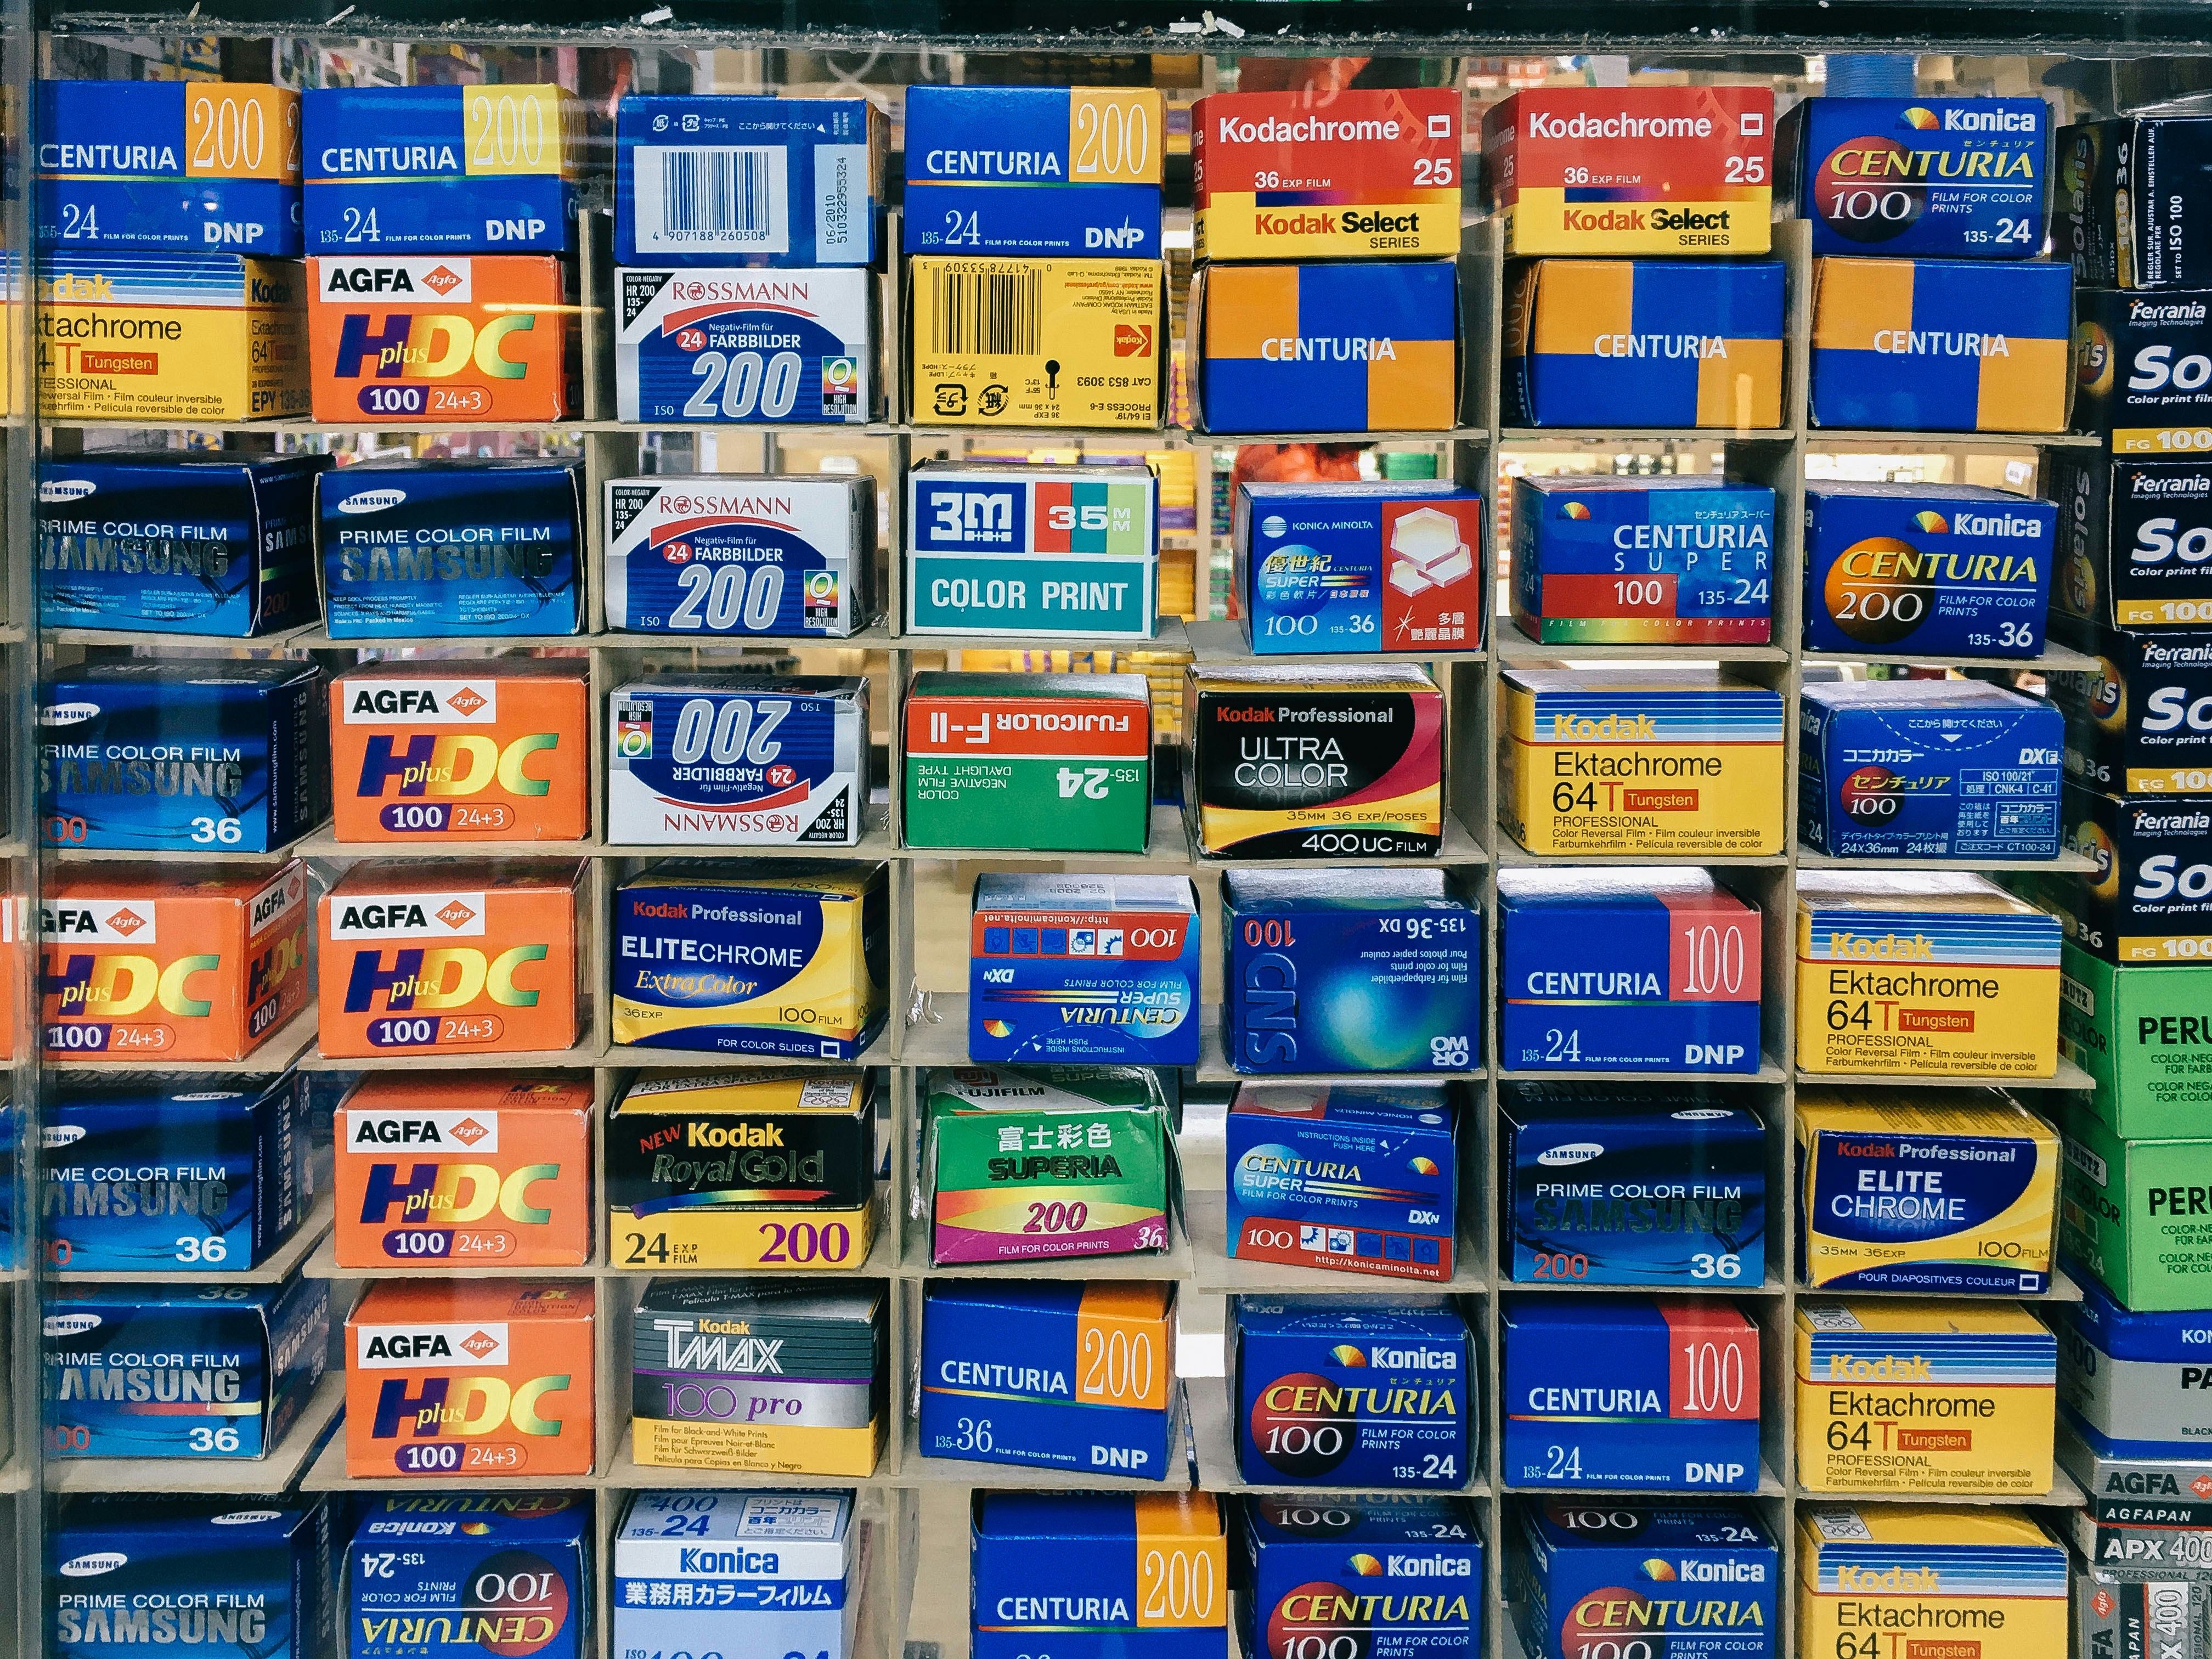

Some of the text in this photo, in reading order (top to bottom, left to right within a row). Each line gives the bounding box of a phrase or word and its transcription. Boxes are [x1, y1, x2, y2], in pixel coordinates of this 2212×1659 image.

[472, 95, 543, 166] 200
[1220, 116, 1400, 143] Kodachrome
[1530, 112, 1712, 139] Kodachrome
[1945, 108, 2035, 132] Konica
[322, 146, 457, 172] CENTURIA
[927, 151, 1061, 176] CENTURIA
[1255, 171, 1331, 188] 36 EXP FILM
[1413, 159, 1452, 185] 25
[1828, 191, 1912, 220] 100
[1932, 193, 2033, 203] FILM FOR COLOR
[1932, 204, 1973, 214] PRINTS
[2170, 196, 2182, 220] 100
[487, 219, 545, 240] DNP
[826, 194, 836, 244] 06/2010
[1255, 211, 1419, 235] Kodak Select
[204, 223, 263, 244] DNP
[668, 230, 766, 241] 907188 260508
[1370, 237, 1420, 249] SERIES
[2170, 225, 2182, 250] ISO
[2176, 253, 2181, 263] TO
[328, 268, 414, 292] AGFA
[427, 274, 456, 286] Agfa
[627, 286, 654, 296] HR 200
[673, 282, 808, 301] ROSSMANN
[709, 323, 759, 331] Negativ-Film
[680, 334, 800, 348] 24 FARBBILDER
[86, 356, 153, 371] Tungsten
[380, 341, 428, 369] plus
[654, 352, 802, 417] ISO 200
[1077, 377, 1151, 387] CAT 853 3093
[370, 388, 481, 410] 100 24+3
[1090, 403, 1151, 411] PROCESS E-6
[2133, 474, 2210, 492] Ferrania
[345, 496, 398, 506] SAMSUNG
[930, 492, 1012, 543] 3M
[1293, 521, 1374, 531] KONICA MINOLTA
[1954, 512, 2041, 538] Konica
[340, 527, 550, 544] PRIME COLOR FILM
[696, 548, 783, 562] FARBBILDER
[1265, 555, 1332, 573] 優世紀
[1615, 551, 1767, 572] SUPER
[1265, 575, 1318, 588] SUPER
[2130, 568, 2196, 577] Color print
[932, 579, 1128, 611] COLOR PRINT
[1613, 581, 1662, 605] 100
[1835, 591, 1922, 622] 200
[996, 714, 1129, 732] FUJICOLOR
[1217, 706, 1393, 724] Kodak Professional
[672, 698, 791, 764] 200
[1553, 714, 1656, 741] Kodak
[1241, 737, 1344, 761] ULTRA
[1843, 749, 1925, 763] コニカカラー
[673, 767, 763, 781] FARBBILDER
[918, 765, 1012, 776] DAYLIGHT TYPE
[1234, 763, 1348, 788] COLOR
[1554, 751, 1722, 777] Ektachrome
[918, 778, 1007, 788] NEGATIVE FILM
[1995, 785, 2023, 794] CNK-4
[2033, 785, 2052, 793] C-41
[1628, 793, 1694, 808] Tungsten
[457, 808, 504, 827] 24+3
[1287, 811, 1351, 820] 35MM 36
[1553, 816, 1658, 827] PROFESSIONAL
[191, 817, 242, 844] 36
[1553, 829, 1646, 838] Color Reversal Film
[1396, 842, 1426, 852] FILM
[1553, 839, 1627, 849] Farbumkehrfilm
[340, 905, 427, 929] AGFA
[633, 901, 802, 926] Kodak Professional
[1361, 951, 1390, 960] couleur
[1393, 949, 1417, 960] papier
[1420, 949, 1447, 959] photos
[1371, 973, 1435, 983] Farbpapierbilder
[1527, 972, 1661, 996] CENTURIA
[1829, 969, 1999, 998] Ektachrome
[1244, 952, 1297, 1065] CNS
[116, 1029, 165, 1047] 24+3
[718, 1039, 815, 1053] FOR COLOR SLIDES
[1685, 1045, 1745, 1064] DNP
[639, 1124, 681, 1153] NEW
[688, 1122, 784, 1147] Kodak
[998, 1124, 1113, 1150] 富士彩色
[988, 1154, 1122, 1181] SUPERIA
[1243, 1154, 1362, 1182] CENTURIA
[1537, 1184, 1740, 1199] PRIME COLOR FILM
[1859, 1170, 1943, 1193] ELITE
[1022, 1202, 1087, 1233] 200
[1832, 1195, 1965, 1221] CHROME
[625, 1233, 669, 1263] 24
[758, 1222, 849, 1262] 200
[1314, 1255, 1440, 1278] http://konicaminolta.net
[1690, 1254, 1741, 1278] 36
[1859, 1273, 2016, 1286] POUR DIAPOSITIVES COULEUR
[699, 1319, 751, 1335] Kodak
[1372, 1346, 1457, 1369] Konica
[941, 1360, 1068, 1395] CENTURIA
[746, 1396, 803, 1421] pro
[1529, 1387, 1661, 1413] CENTURIA
[684, 1426, 768, 1438] Black-and-White Prints
[1393, 1454, 1457, 1479] 135-24
[2106, 1471, 2179, 1495] AGFA
[2106, 1508, 2191, 1522] AGFAPAN
[680, 1547, 779, 1574] Konica
[2104, 1539, 2163, 1560] APX
[1681, 1559, 1765, 1582] Konica
[1838, 1565, 1940, 1592] Kodak
[625, 1583, 832, 1607] 業務用カラーフィルム
[997, 1597, 1129, 1621] CENTURIA
[58, 1610, 265, 1643] SAMSUNG
[362, 1617, 554, 1643] CENTURIA
